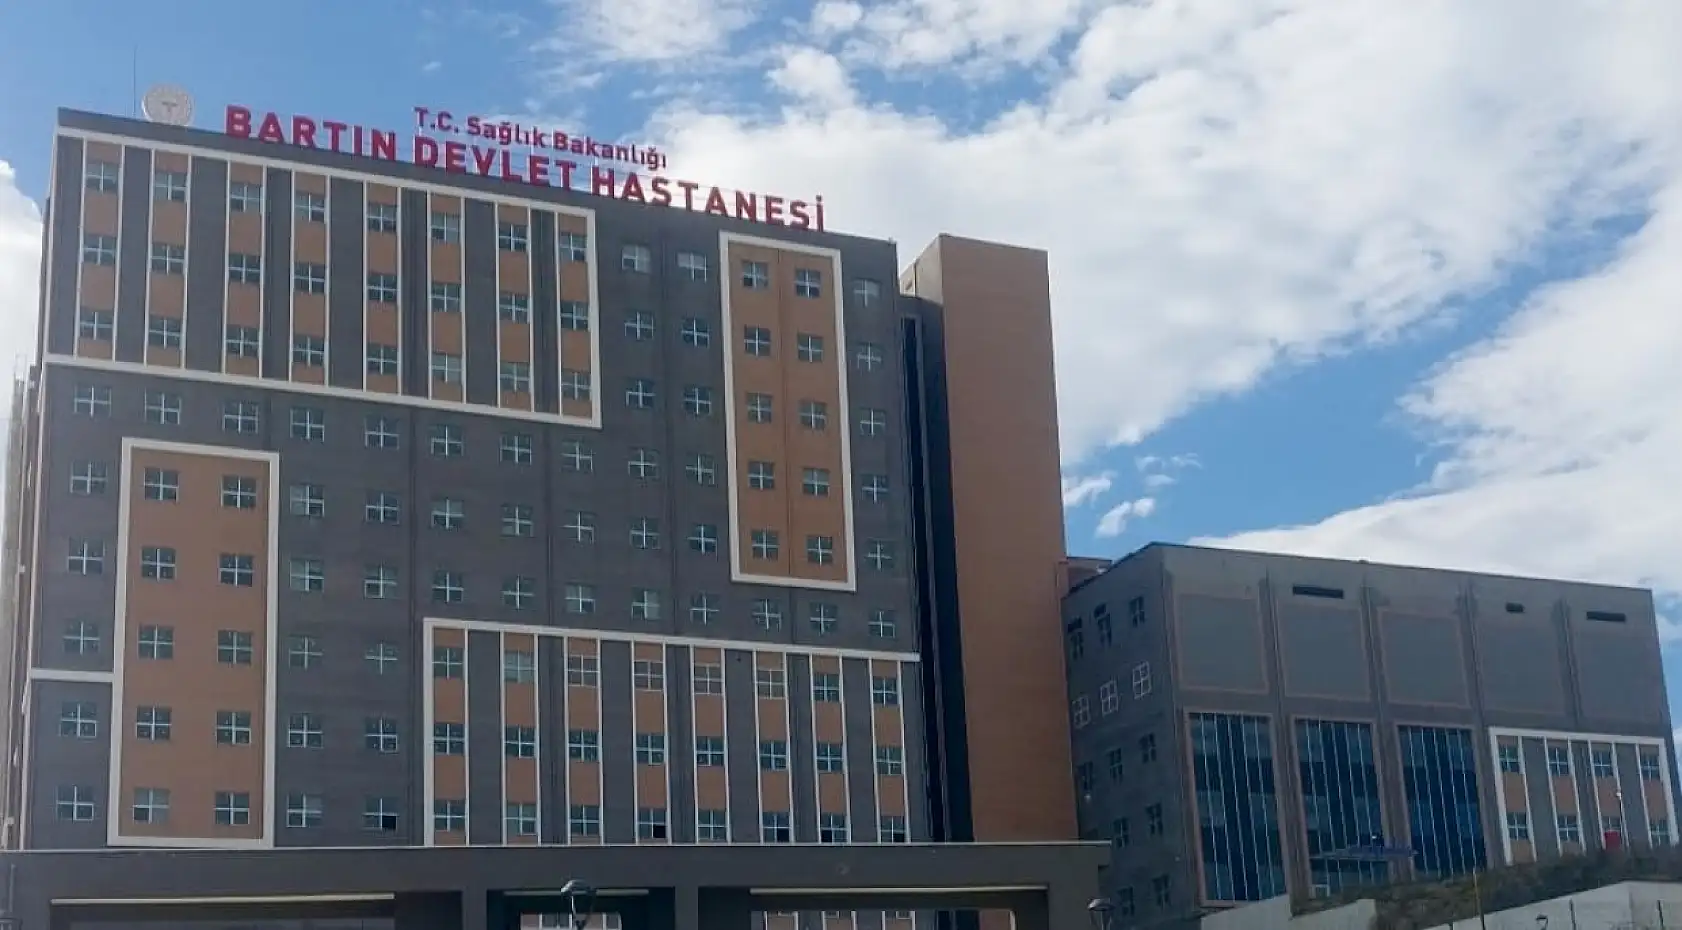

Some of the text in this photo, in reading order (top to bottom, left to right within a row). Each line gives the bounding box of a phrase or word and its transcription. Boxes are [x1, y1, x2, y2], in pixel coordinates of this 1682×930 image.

[225, 104, 825, 231] BARTIN DEVLET HASTANESİ
[414, 106, 667, 170] T.C. Sağlık Bakanlığı
